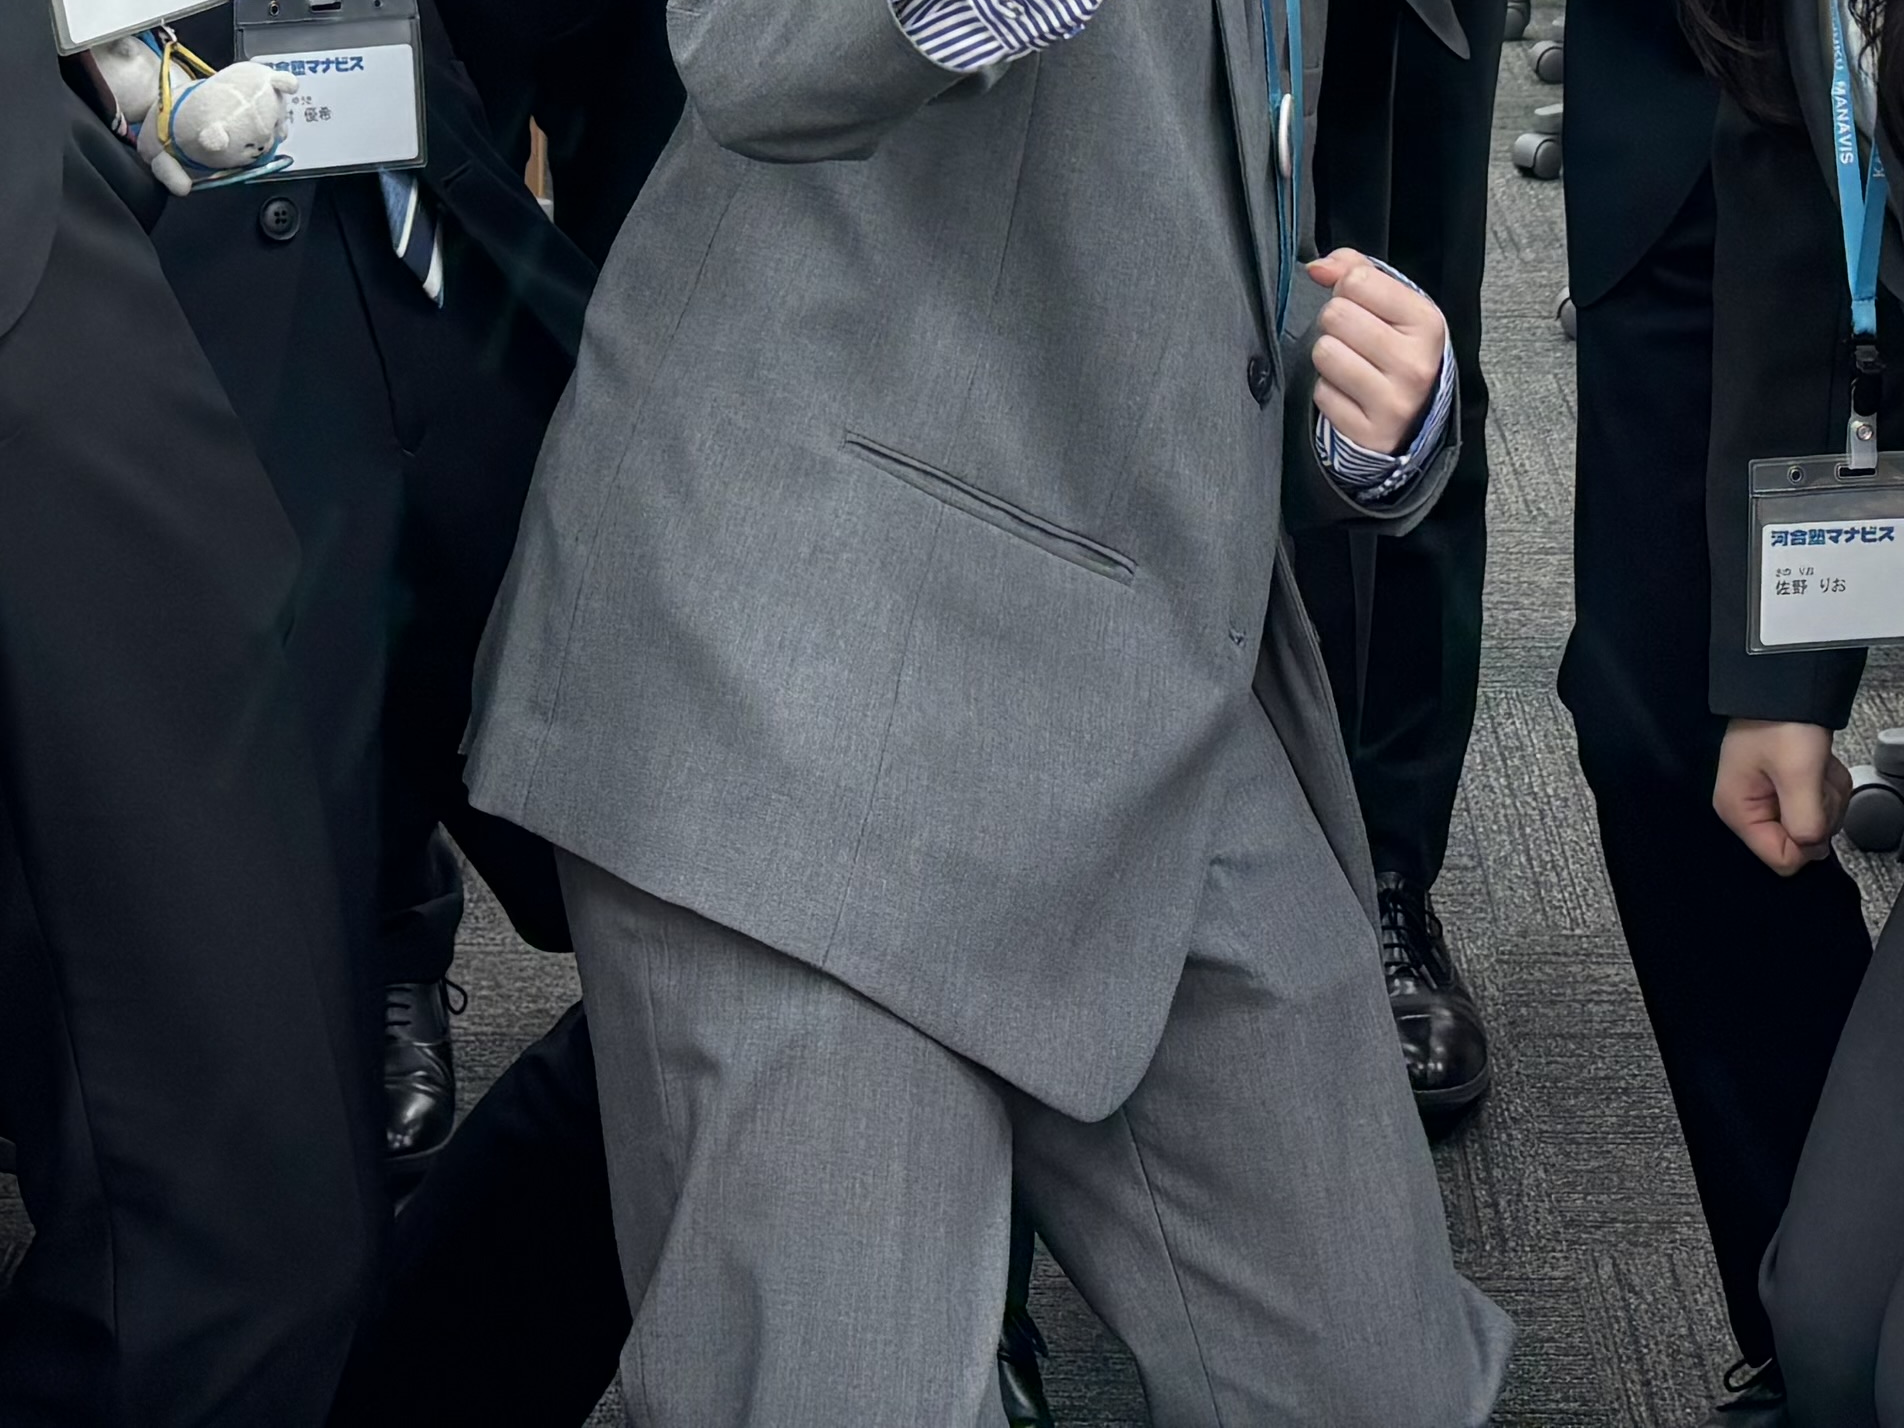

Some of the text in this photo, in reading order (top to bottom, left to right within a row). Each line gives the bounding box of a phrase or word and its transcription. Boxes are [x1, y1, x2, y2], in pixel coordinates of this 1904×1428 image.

[1832, 81, 1854, 164] MANAVIS
[1771, 526, 1895, 547] 河合塾マナビス
[1776, 577, 1846, 595] 佐野 りお
